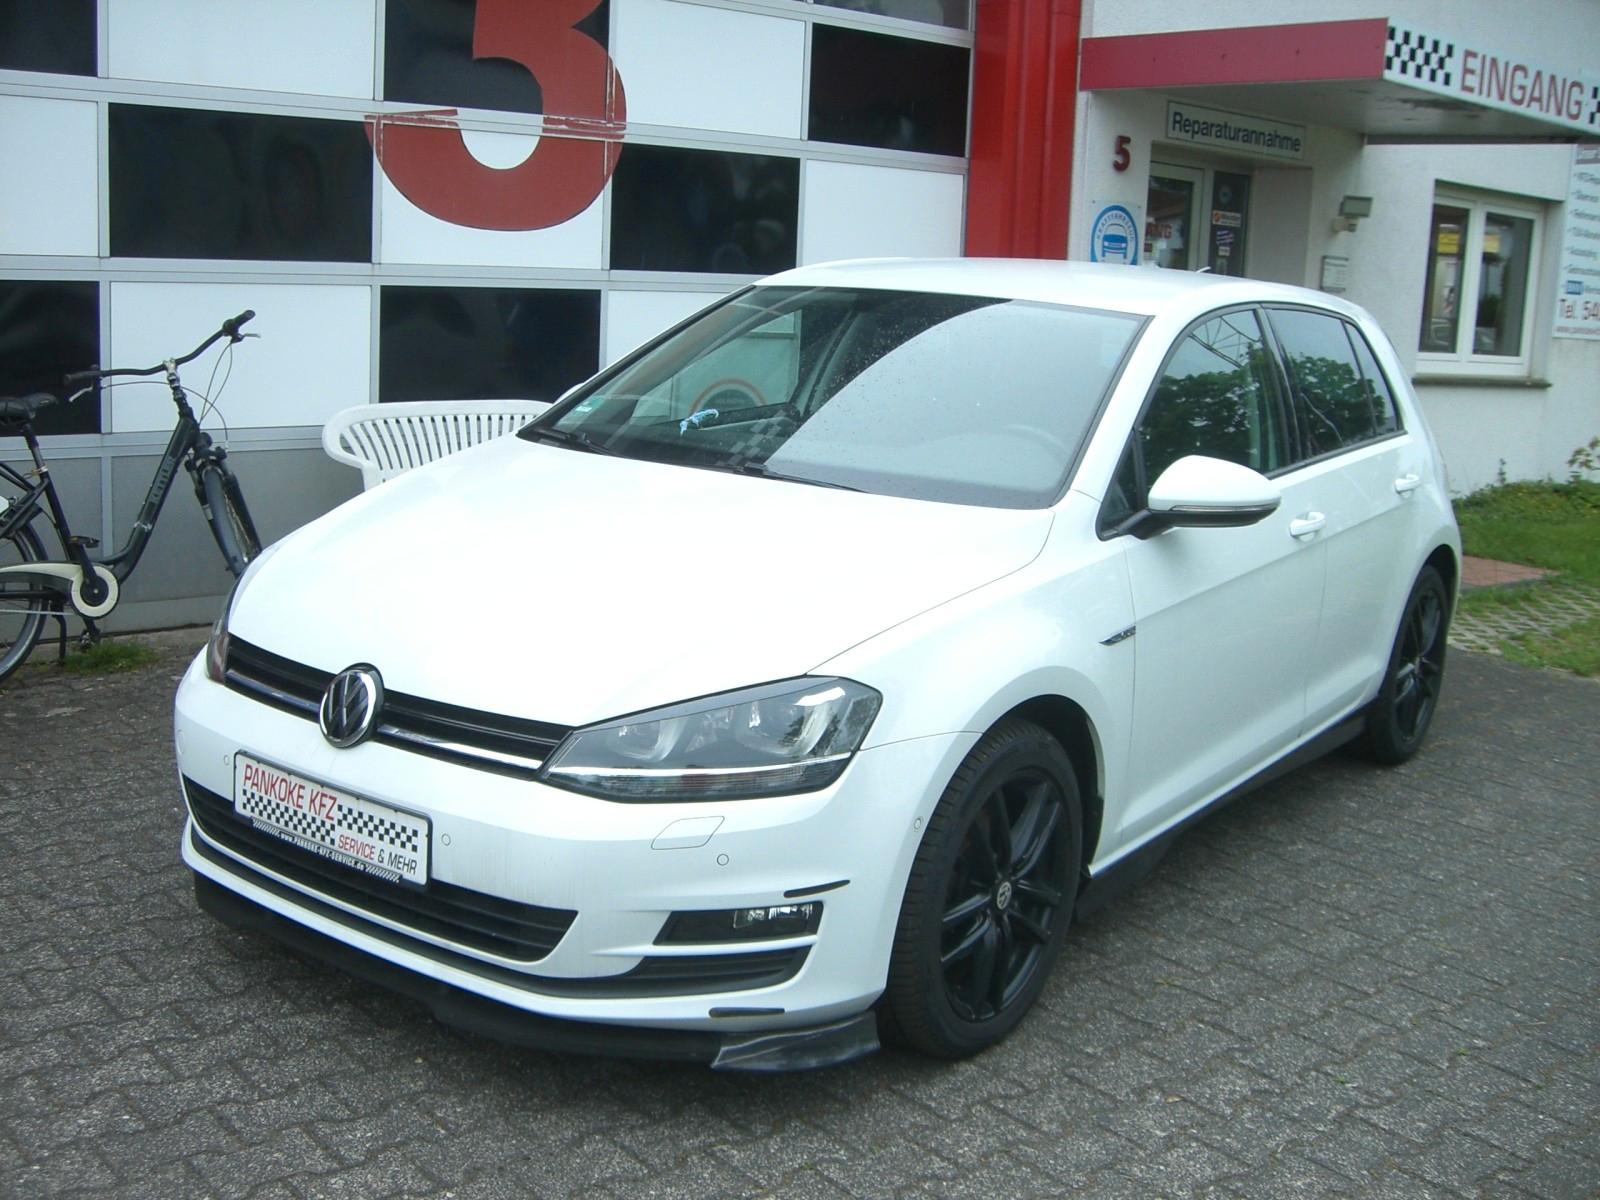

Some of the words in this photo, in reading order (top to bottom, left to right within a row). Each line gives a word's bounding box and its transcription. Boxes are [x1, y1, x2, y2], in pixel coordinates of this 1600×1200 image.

[1461, 48, 1584, 121] EINGANG
[364, 0, 627, 231] 3
[1172, 111, 1301, 152] Reparaturannahme
[1112, 135, 1131, 172] 5
[1583, 300, 1600, 321] 54
[243, 763, 306, 810] PANKOKE
[308, 788, 338, 822] KFZ
[338, 833, 376, 861] SERVICE
[377, 847, 385, 864] &
[387, 850, 417, 876] MEHR
